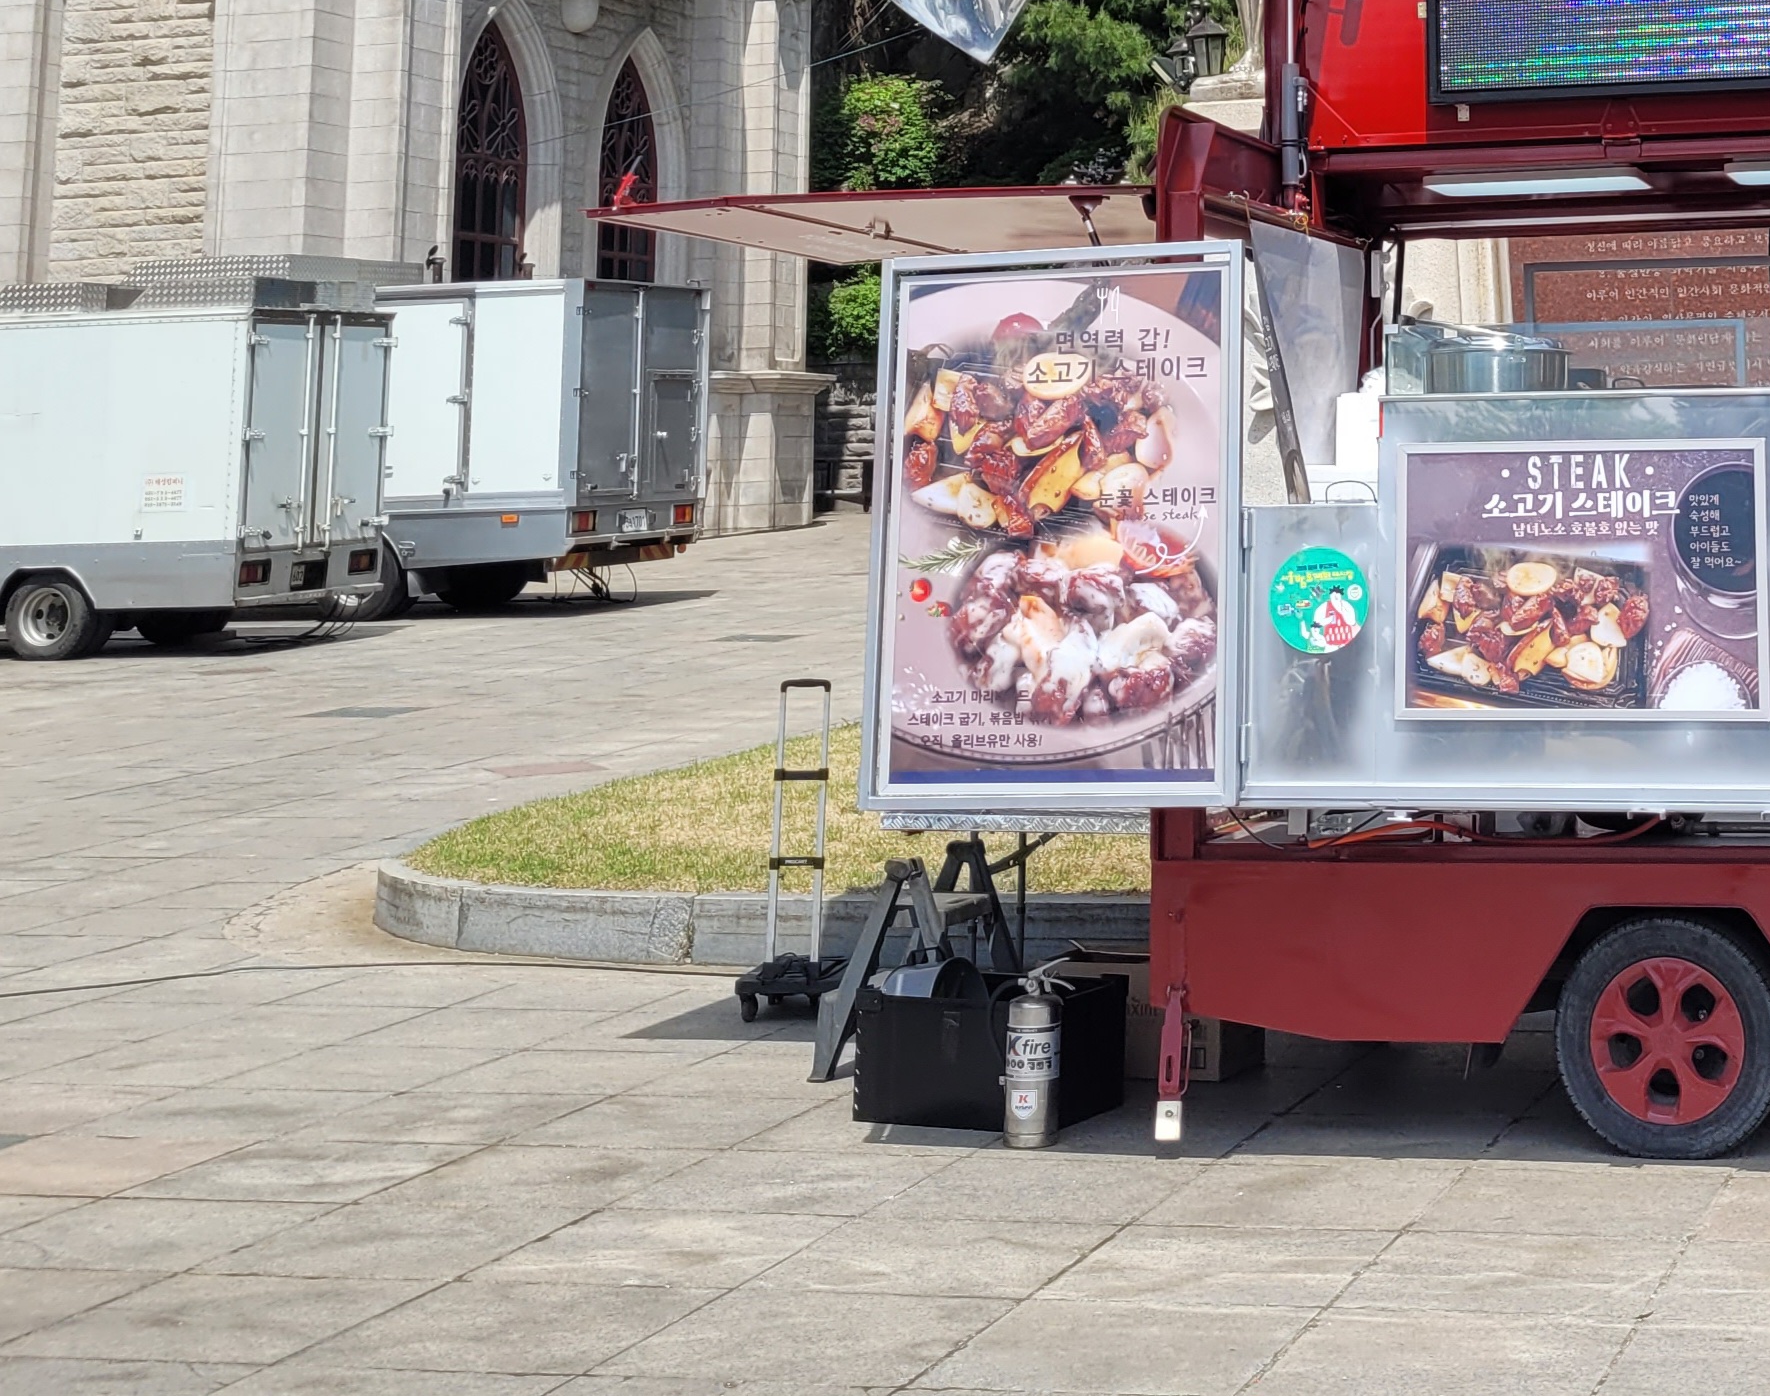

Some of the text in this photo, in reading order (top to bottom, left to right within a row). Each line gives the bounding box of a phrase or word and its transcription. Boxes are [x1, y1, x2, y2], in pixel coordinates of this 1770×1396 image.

[1055, 327, 1170, 354] 면역력 갑!
[1026, 356, 1208, 385] 소고기 스테이크
[1527, 454, 1631, 489] STEAK
[1099, 486, 1217, 508] 눈꽃 스테이크
[1482, 489, 1680, 519] 소고기 스테이크
[1688, 494, 1719, 506] 맛있게
[1162, 507, 1199, 521] steak
[1688, 509, 1720, 522] 숙성해
[1513, 522, 1567, 538] 남녀노소
[1570, 521, 1612, 537] 호불호
[1645, 520, 1660, 536] 맛
[1689, 525, 1731, 537] 부드럽고
[1689, 540, 1732, 553] 아이들도
[1690, 557, 1701, 569] 잘
[932, 690, 967, 704] 소고기
[907, 712, 955, 726] 스테이크
[989, 711, 1024, 726] 볶음밥
[920, 733, 1043, 749] 오직 올리브유만 사용!
